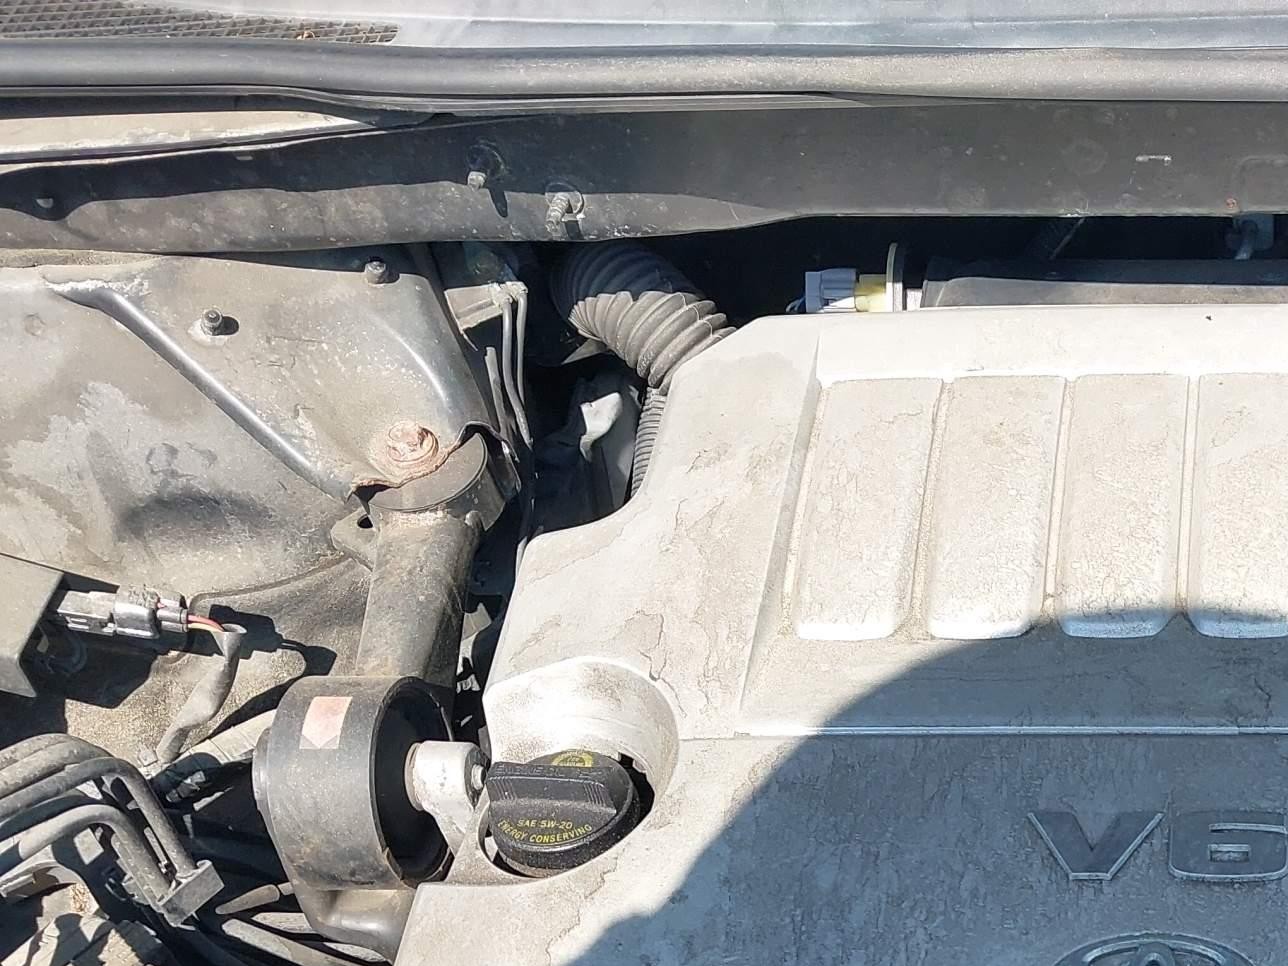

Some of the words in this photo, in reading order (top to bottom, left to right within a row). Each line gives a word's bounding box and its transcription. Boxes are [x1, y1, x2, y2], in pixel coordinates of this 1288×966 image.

[498, 819, 527, 840] ENERGY
[529, 823, 593, 843] CONSERVING
[517, 819, 537, 828] SAE
[540, 819, 573, 830] 5W-20
